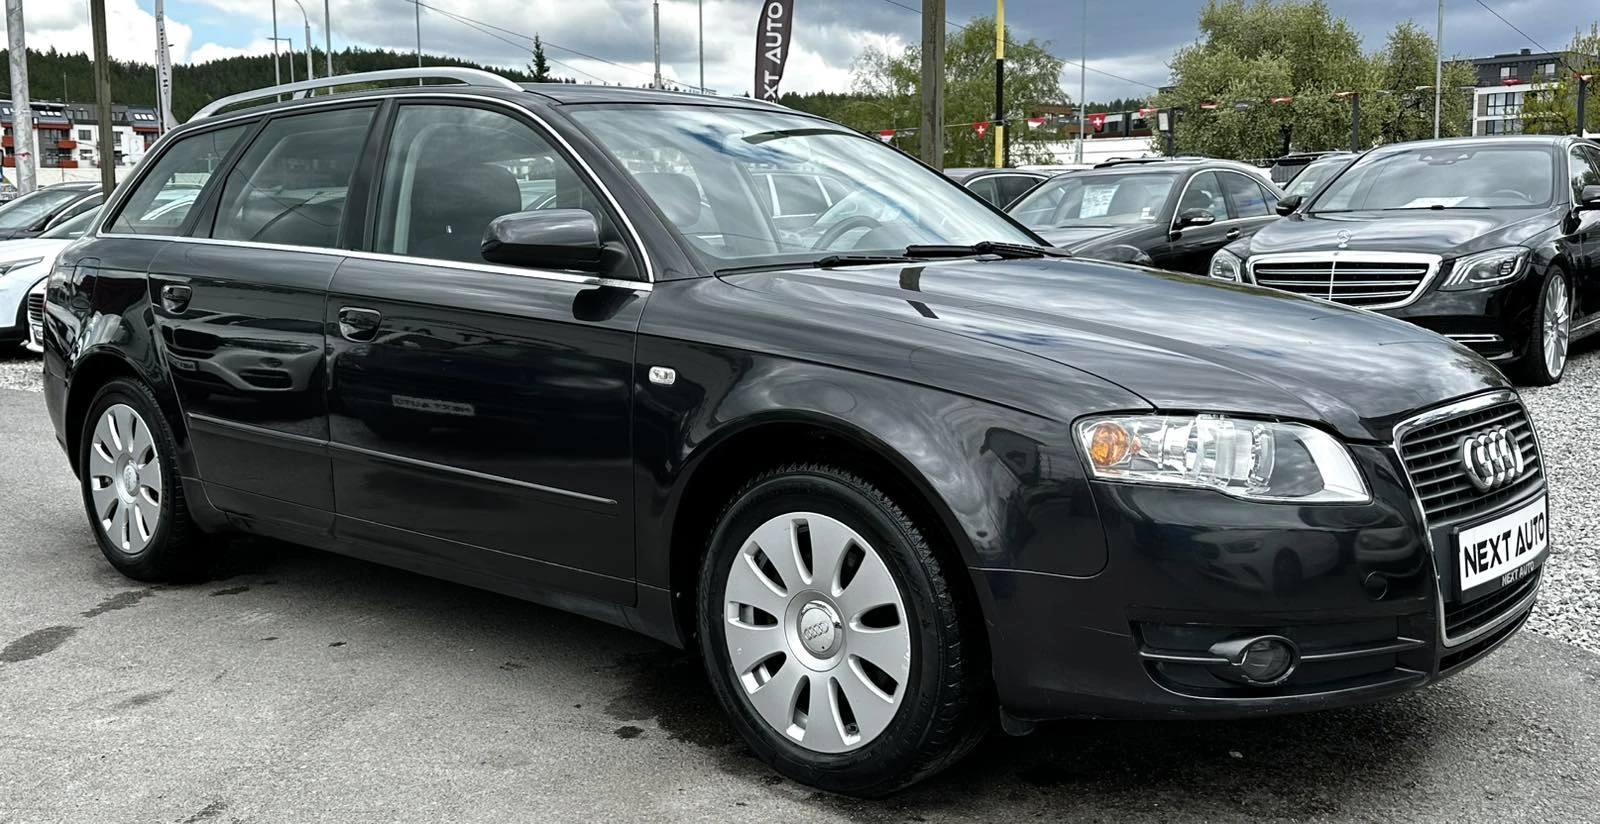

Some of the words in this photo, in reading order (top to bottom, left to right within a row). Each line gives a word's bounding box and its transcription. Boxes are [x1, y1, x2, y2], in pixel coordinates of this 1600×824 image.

[765, 2, 783, 64] AUTO
[763, 70, 779, 103] XT
[1464, 529, 1512, 578] NEXT
[1515, 512, 1545, 557] AUTO
[1502, 569, 1519, 587] NEXT
[1519, 561, 1534, 577] AUTO
